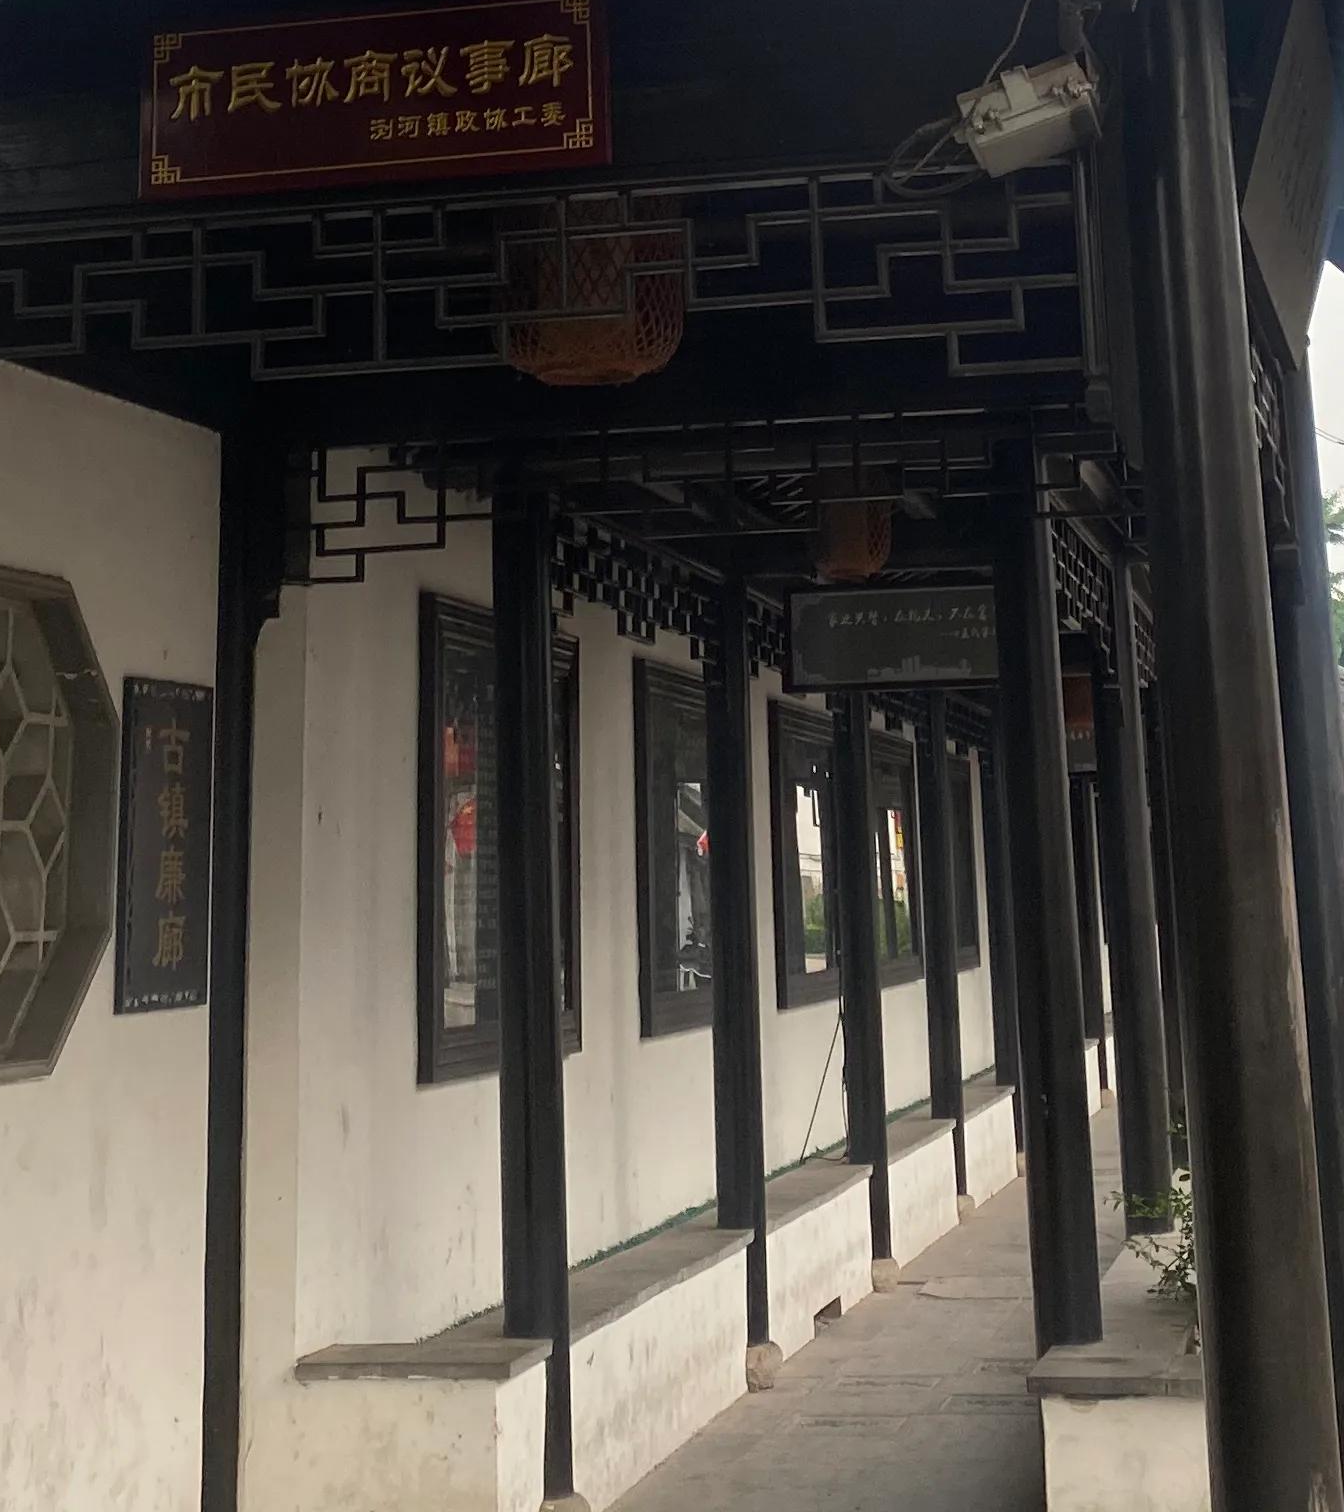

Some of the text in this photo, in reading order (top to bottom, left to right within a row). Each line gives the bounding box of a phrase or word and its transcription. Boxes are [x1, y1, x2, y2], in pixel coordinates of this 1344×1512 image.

[168, 32, 576, 122] 市民协商议事廊
[369, 101, 567, 140] 浏河镇政协工委
[151, 716, 191, 971] 古镇廉廊
